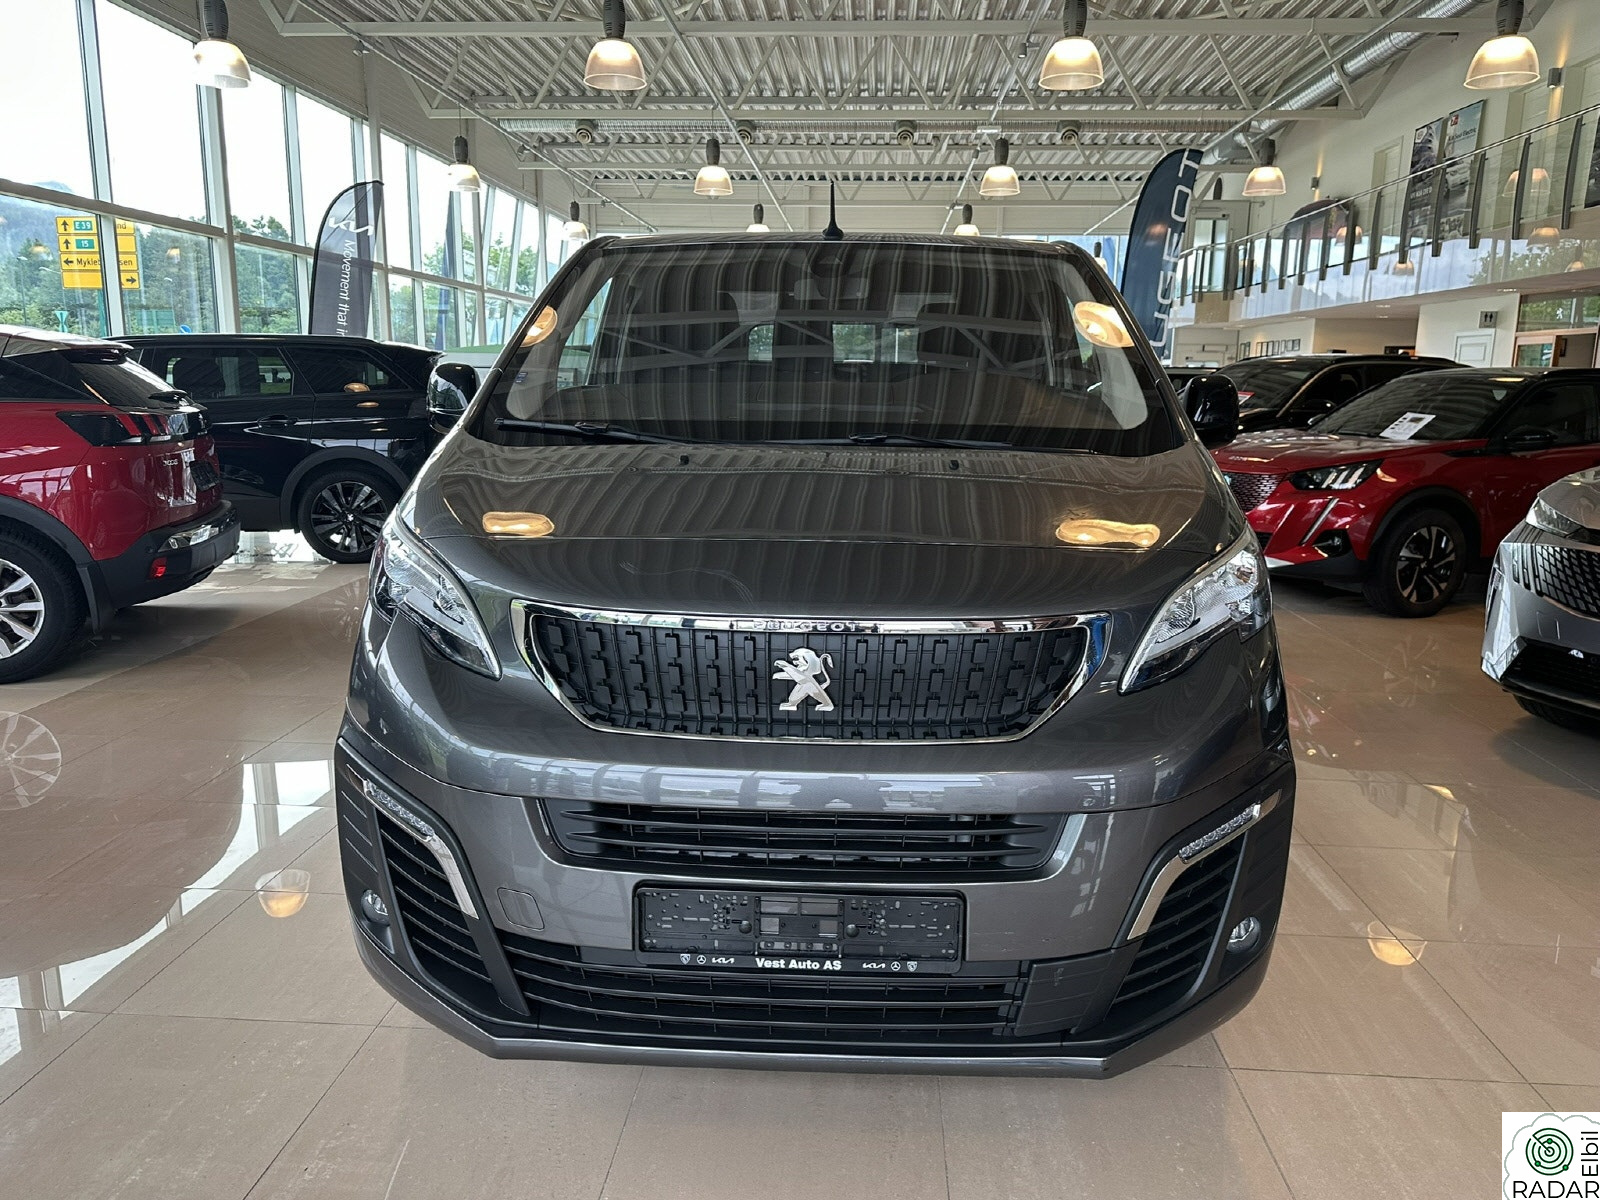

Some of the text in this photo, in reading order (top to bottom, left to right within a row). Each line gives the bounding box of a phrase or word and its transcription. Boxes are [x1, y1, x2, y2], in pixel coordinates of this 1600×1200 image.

[80, 240, 89, 248] 15
[1150, 148, 1199, 347] UGEOT
[338, 240, 356, 300] Movement
[337, 303, 350, 326] that
[753, 620, 858, 631] PEUGEOT
[755, 957, 785, 969] Vest
[788, 959, 820, 970] Auto
[823, 961, 842, 971] AS
